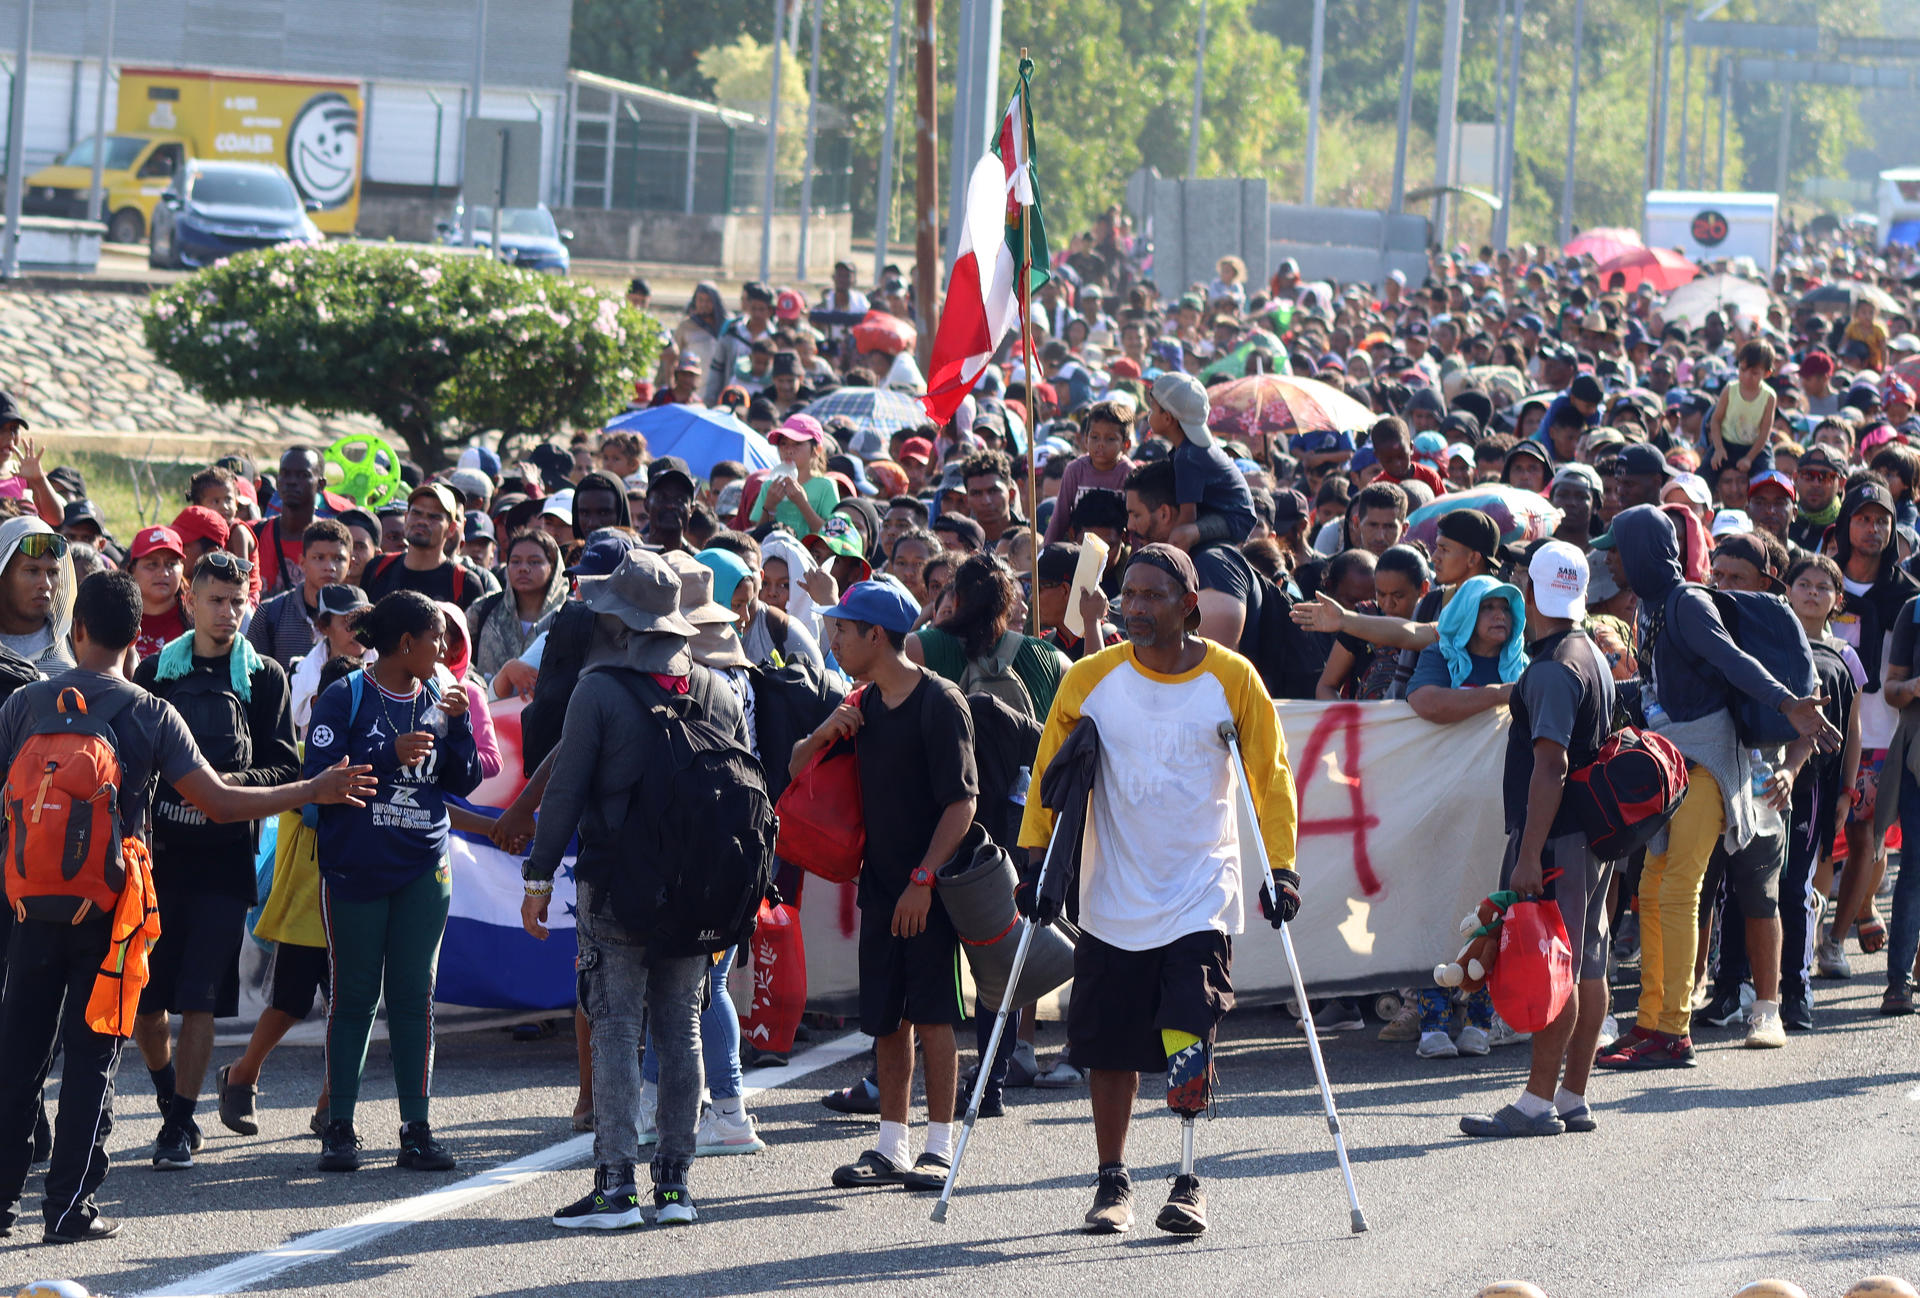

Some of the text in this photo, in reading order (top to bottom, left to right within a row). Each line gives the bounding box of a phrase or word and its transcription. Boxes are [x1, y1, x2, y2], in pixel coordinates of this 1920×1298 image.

[215, 132, 274, 154] COMER
[1558, 567, 1577, 577] SASIL
[1297, 702, 1381, 897] A
